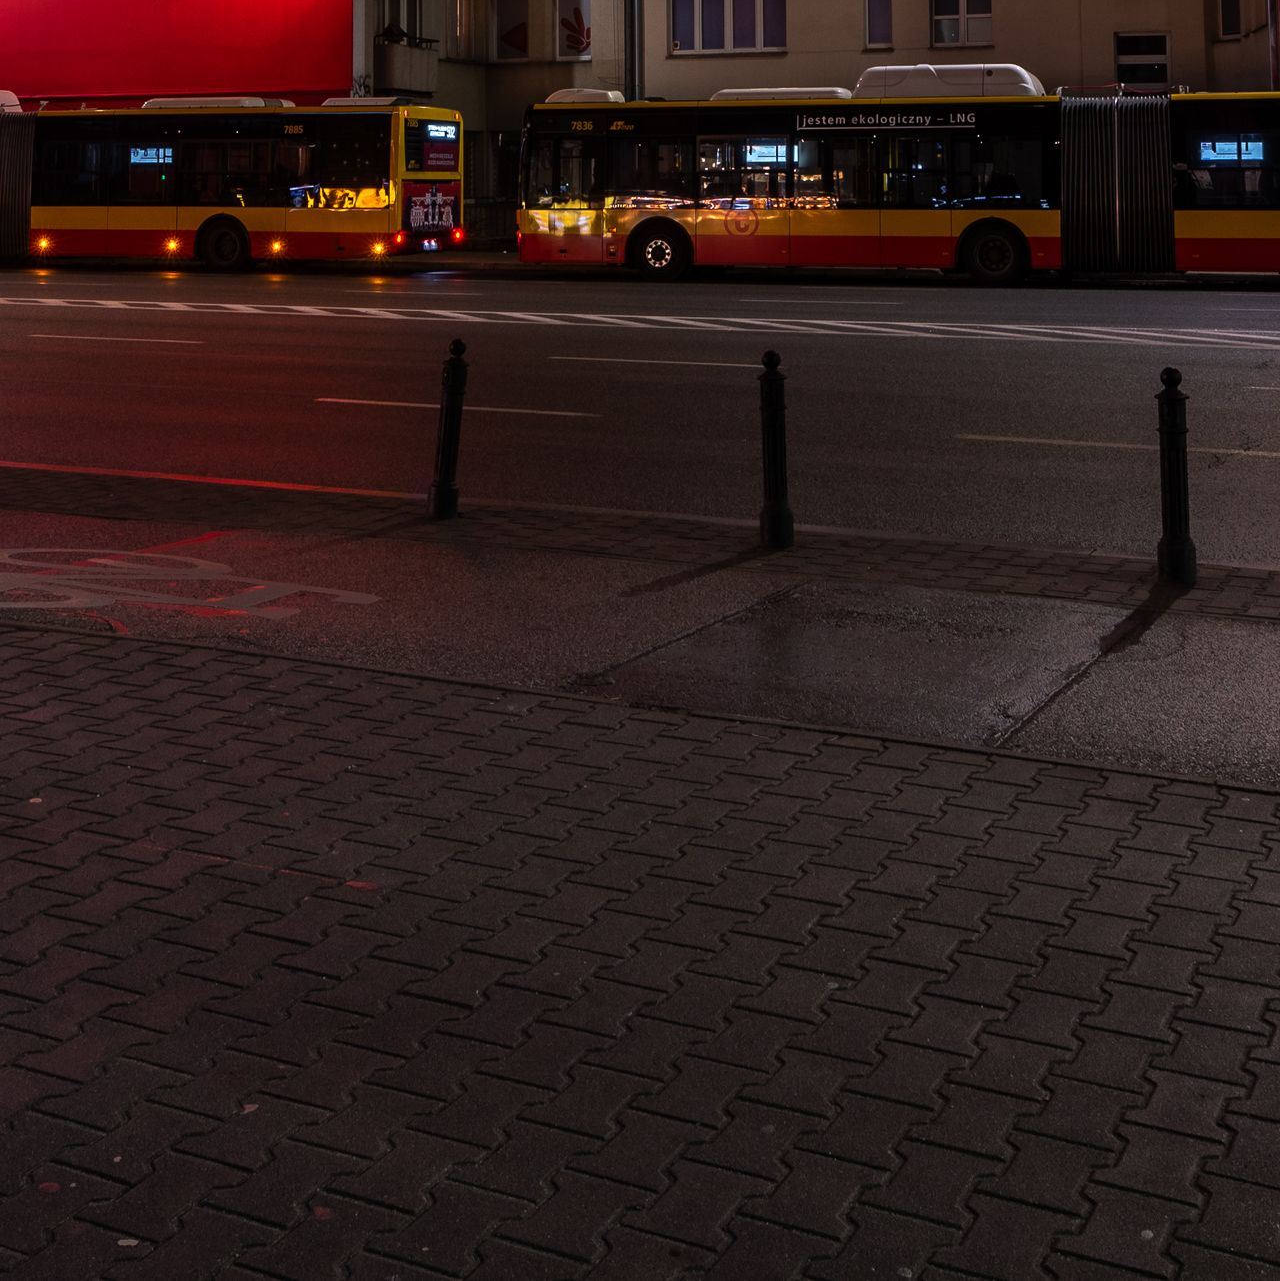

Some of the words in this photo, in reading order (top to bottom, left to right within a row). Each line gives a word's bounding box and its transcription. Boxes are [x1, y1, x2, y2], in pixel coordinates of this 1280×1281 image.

[802, 114, 846, 127] jestem
[851, 113, 932, 126] ekologiczny
[949, 113, 976, 124] LNG
[283, 125, 304, 135] 7885
[570, 121, 593, 131] 7836
